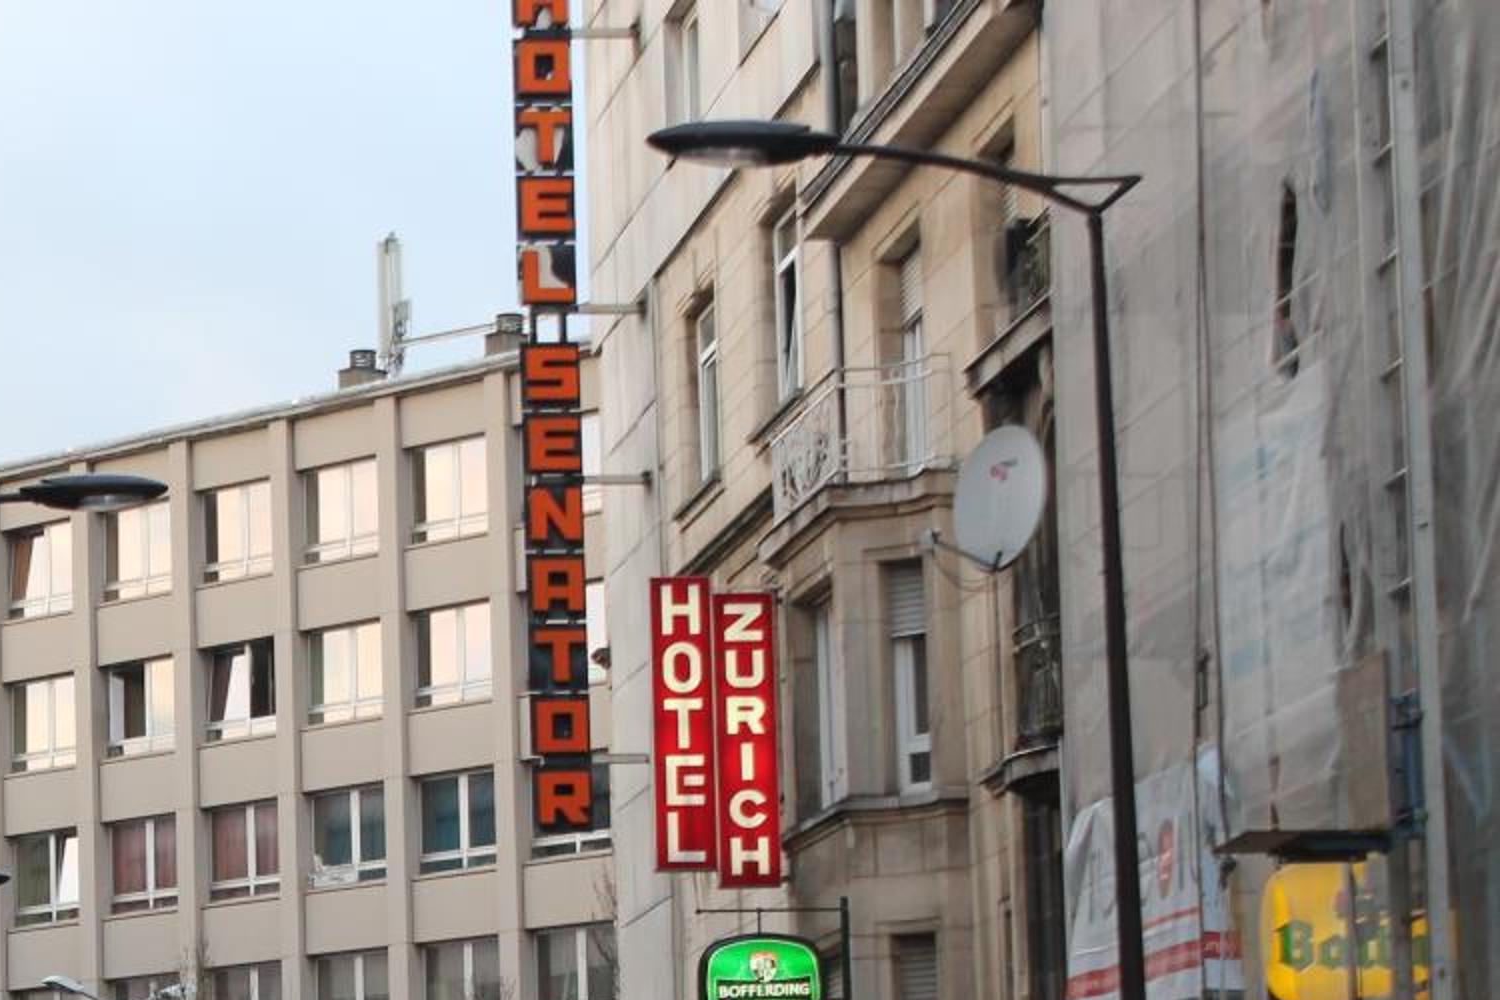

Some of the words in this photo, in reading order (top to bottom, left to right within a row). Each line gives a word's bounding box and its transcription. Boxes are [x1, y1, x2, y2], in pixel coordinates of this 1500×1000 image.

[525, 350, 591, 827] SENATOR
[660, 584, 706, 862] HOTEL
[723, 603, 769, 876] ZURICH
[718, 981, 811, 999] BOFFERDING
